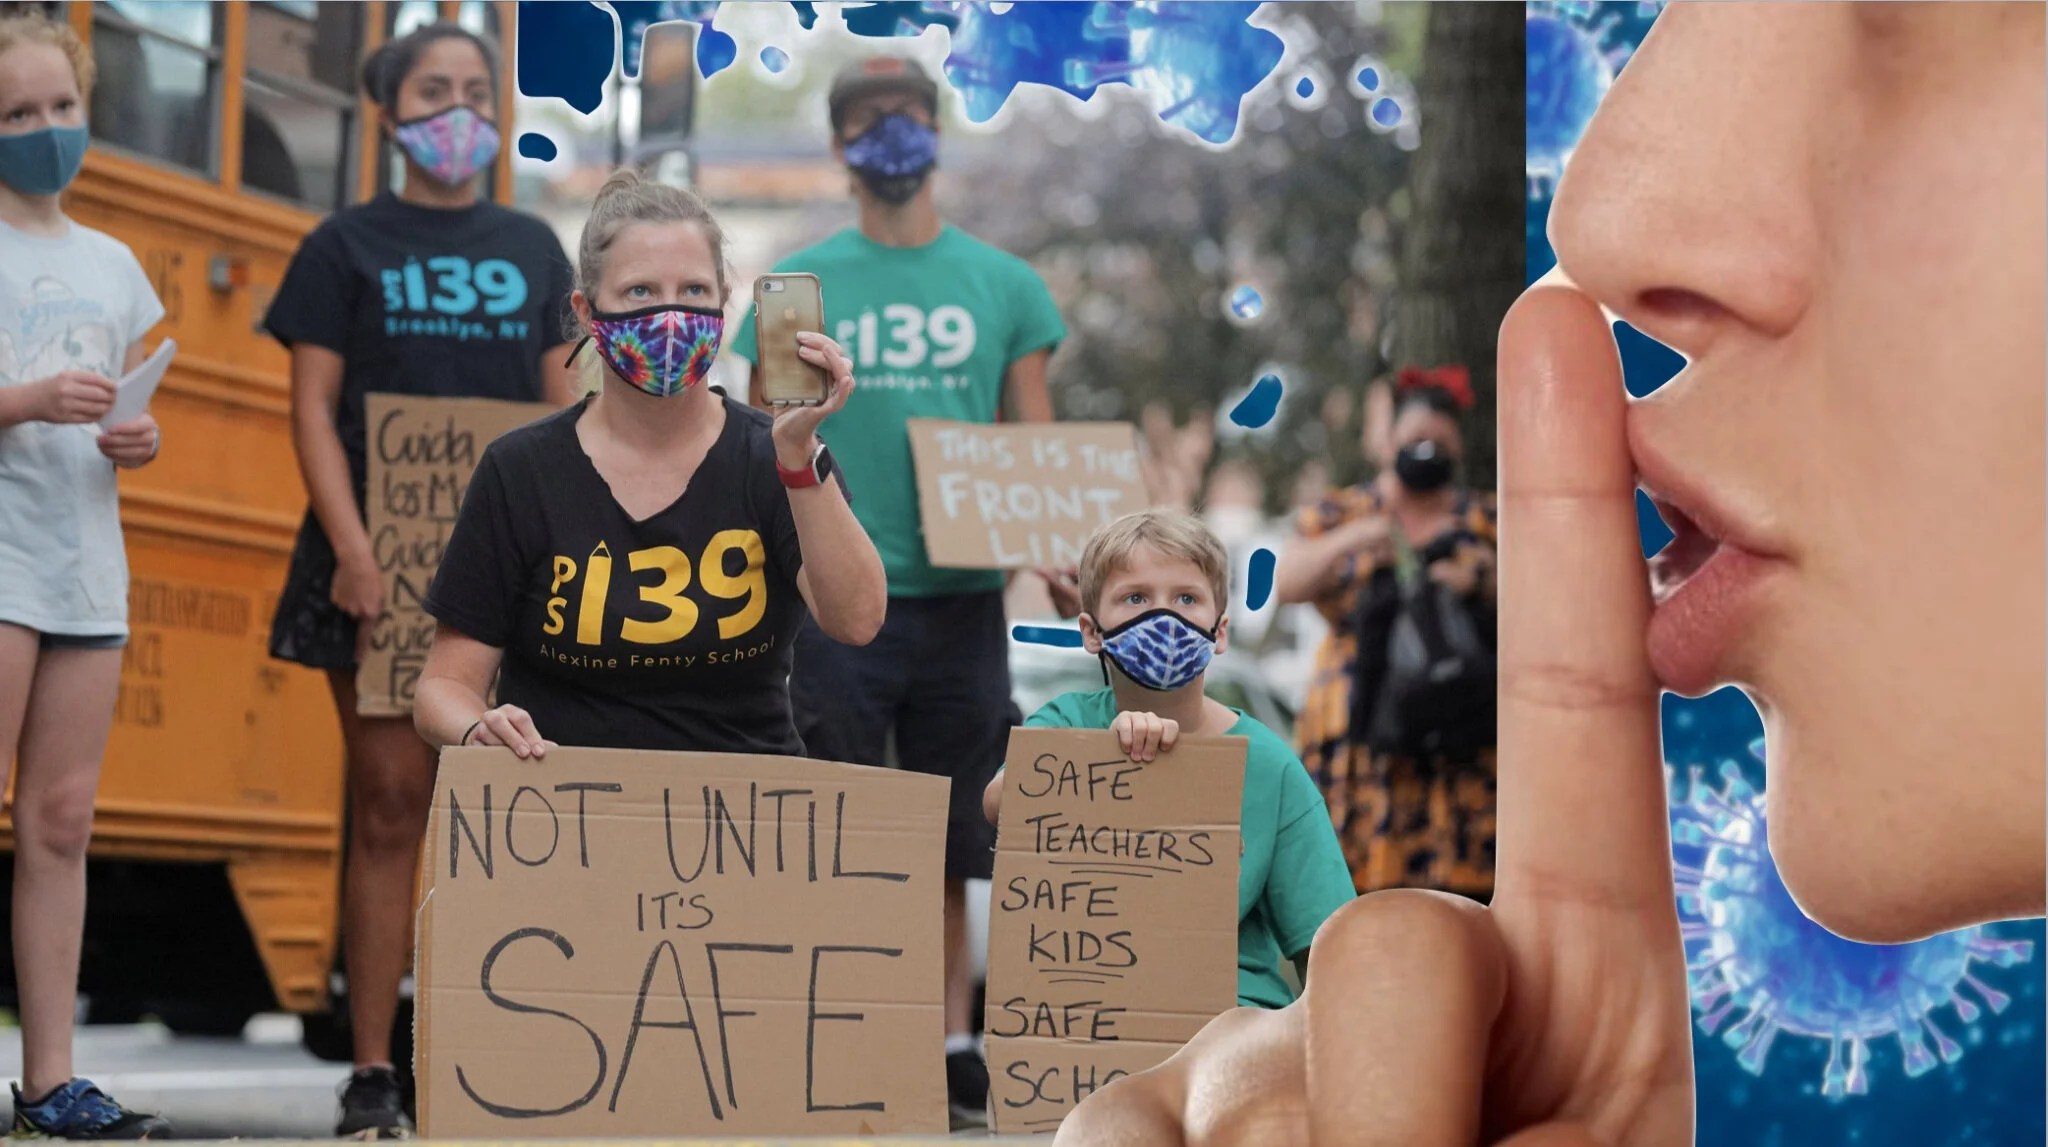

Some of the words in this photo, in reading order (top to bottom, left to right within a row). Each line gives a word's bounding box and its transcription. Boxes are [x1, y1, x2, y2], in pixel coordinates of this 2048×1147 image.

[403, 255, 528, 316] 139
[858, 304, 976, 368] 139
[377, 408, 475, 467] Cuida
[935, 428, 1015, 470] THIS
[1030, 437, 1070, 468] IS
[1081, 444, 1138, 482] THE
[383, 469, 423, 518] los
[937, 471, 1123, 524] FRONT
[374, 523, 446, 572] Cuid
[988, 527, 1086, 566] LIN
[543, 555, 577, 635] PS
[577, 529, 767, 646] 139
[539, 644, 617, 668] Alexine
[630, 654, 696, 667] Fenty
[707, 635, 775, 664] School
[1019, 754, 1143, 801] SAFE
[450, 782, 622, 879] NOT
[663, 781, 910, 883] UNTIL
[1025, 812, 1214, 866] TEACHERS
[636, 892, 713, 931] IT'S
[1001, 877, 1119, 917] SAFE
[1029, 923, 1138, 967] KIDS
[455, 927, 903, 1121] SAFE
[991, 997, 1126, 1041] SAFE
[1004, 1061, 1130, 1108] SCH
